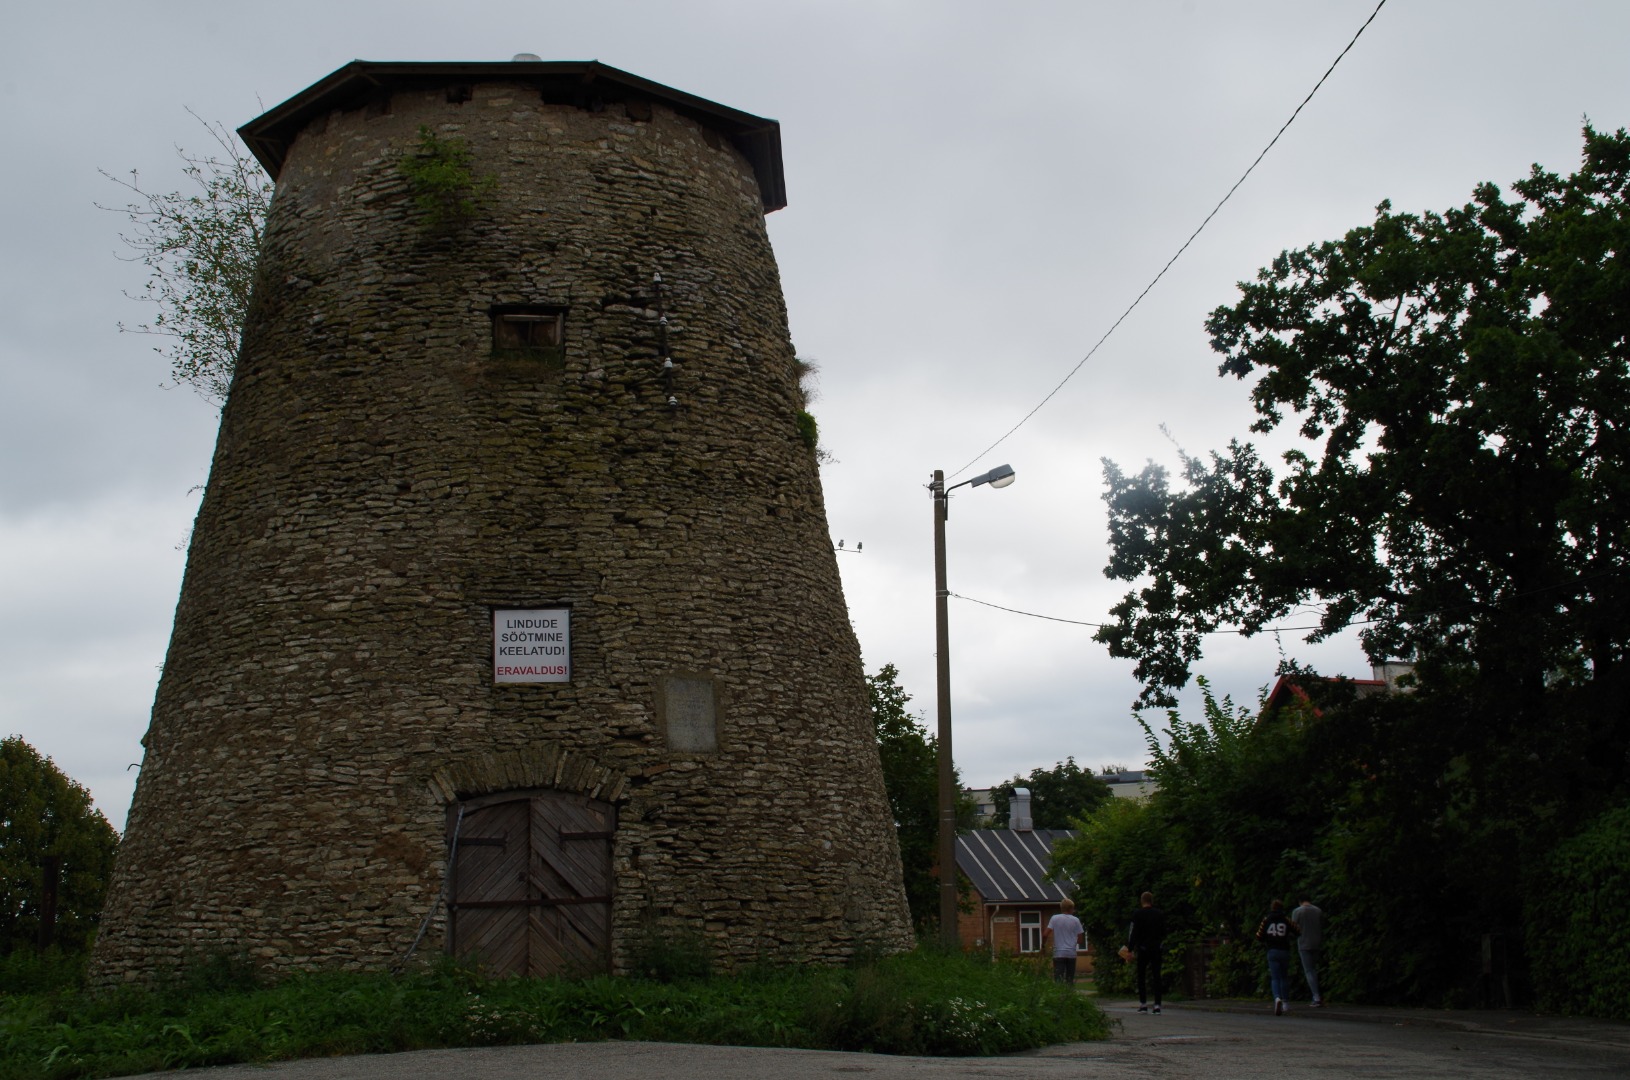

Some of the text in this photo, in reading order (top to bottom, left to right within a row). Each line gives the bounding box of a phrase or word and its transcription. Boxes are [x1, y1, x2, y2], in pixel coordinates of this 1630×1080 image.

[507, 619, 558, 629] LINDUDE
[501, 631, 563, 642] SÖÖTMINE
[499, 646, 565, 656] KEELATUD!
[497, 666, 567, 676] ERAVALDUS!
[1266, 922, 1287, 937] 49
